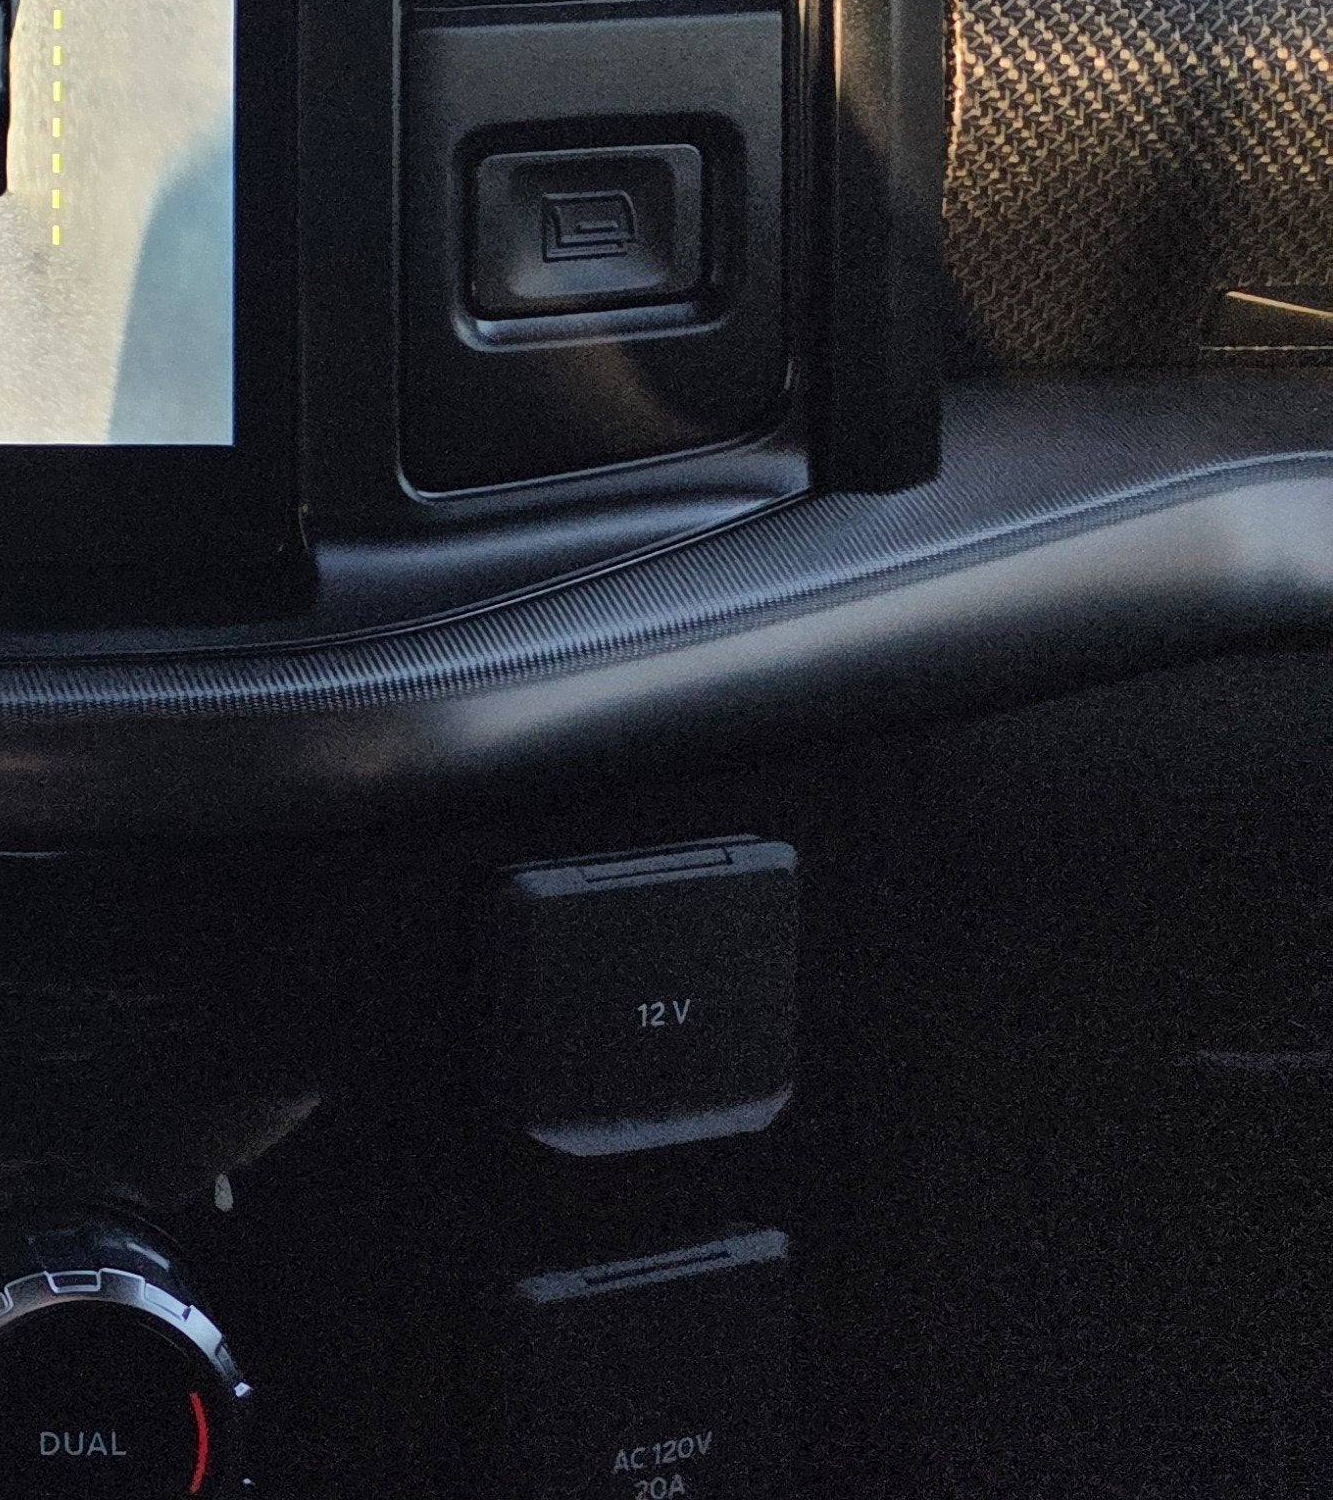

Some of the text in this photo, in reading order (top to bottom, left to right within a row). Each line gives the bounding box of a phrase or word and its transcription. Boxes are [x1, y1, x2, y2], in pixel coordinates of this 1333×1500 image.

[40, 1431, 126, 1456] DUAL
[613, 1432, 712, 1473] AC 120V
